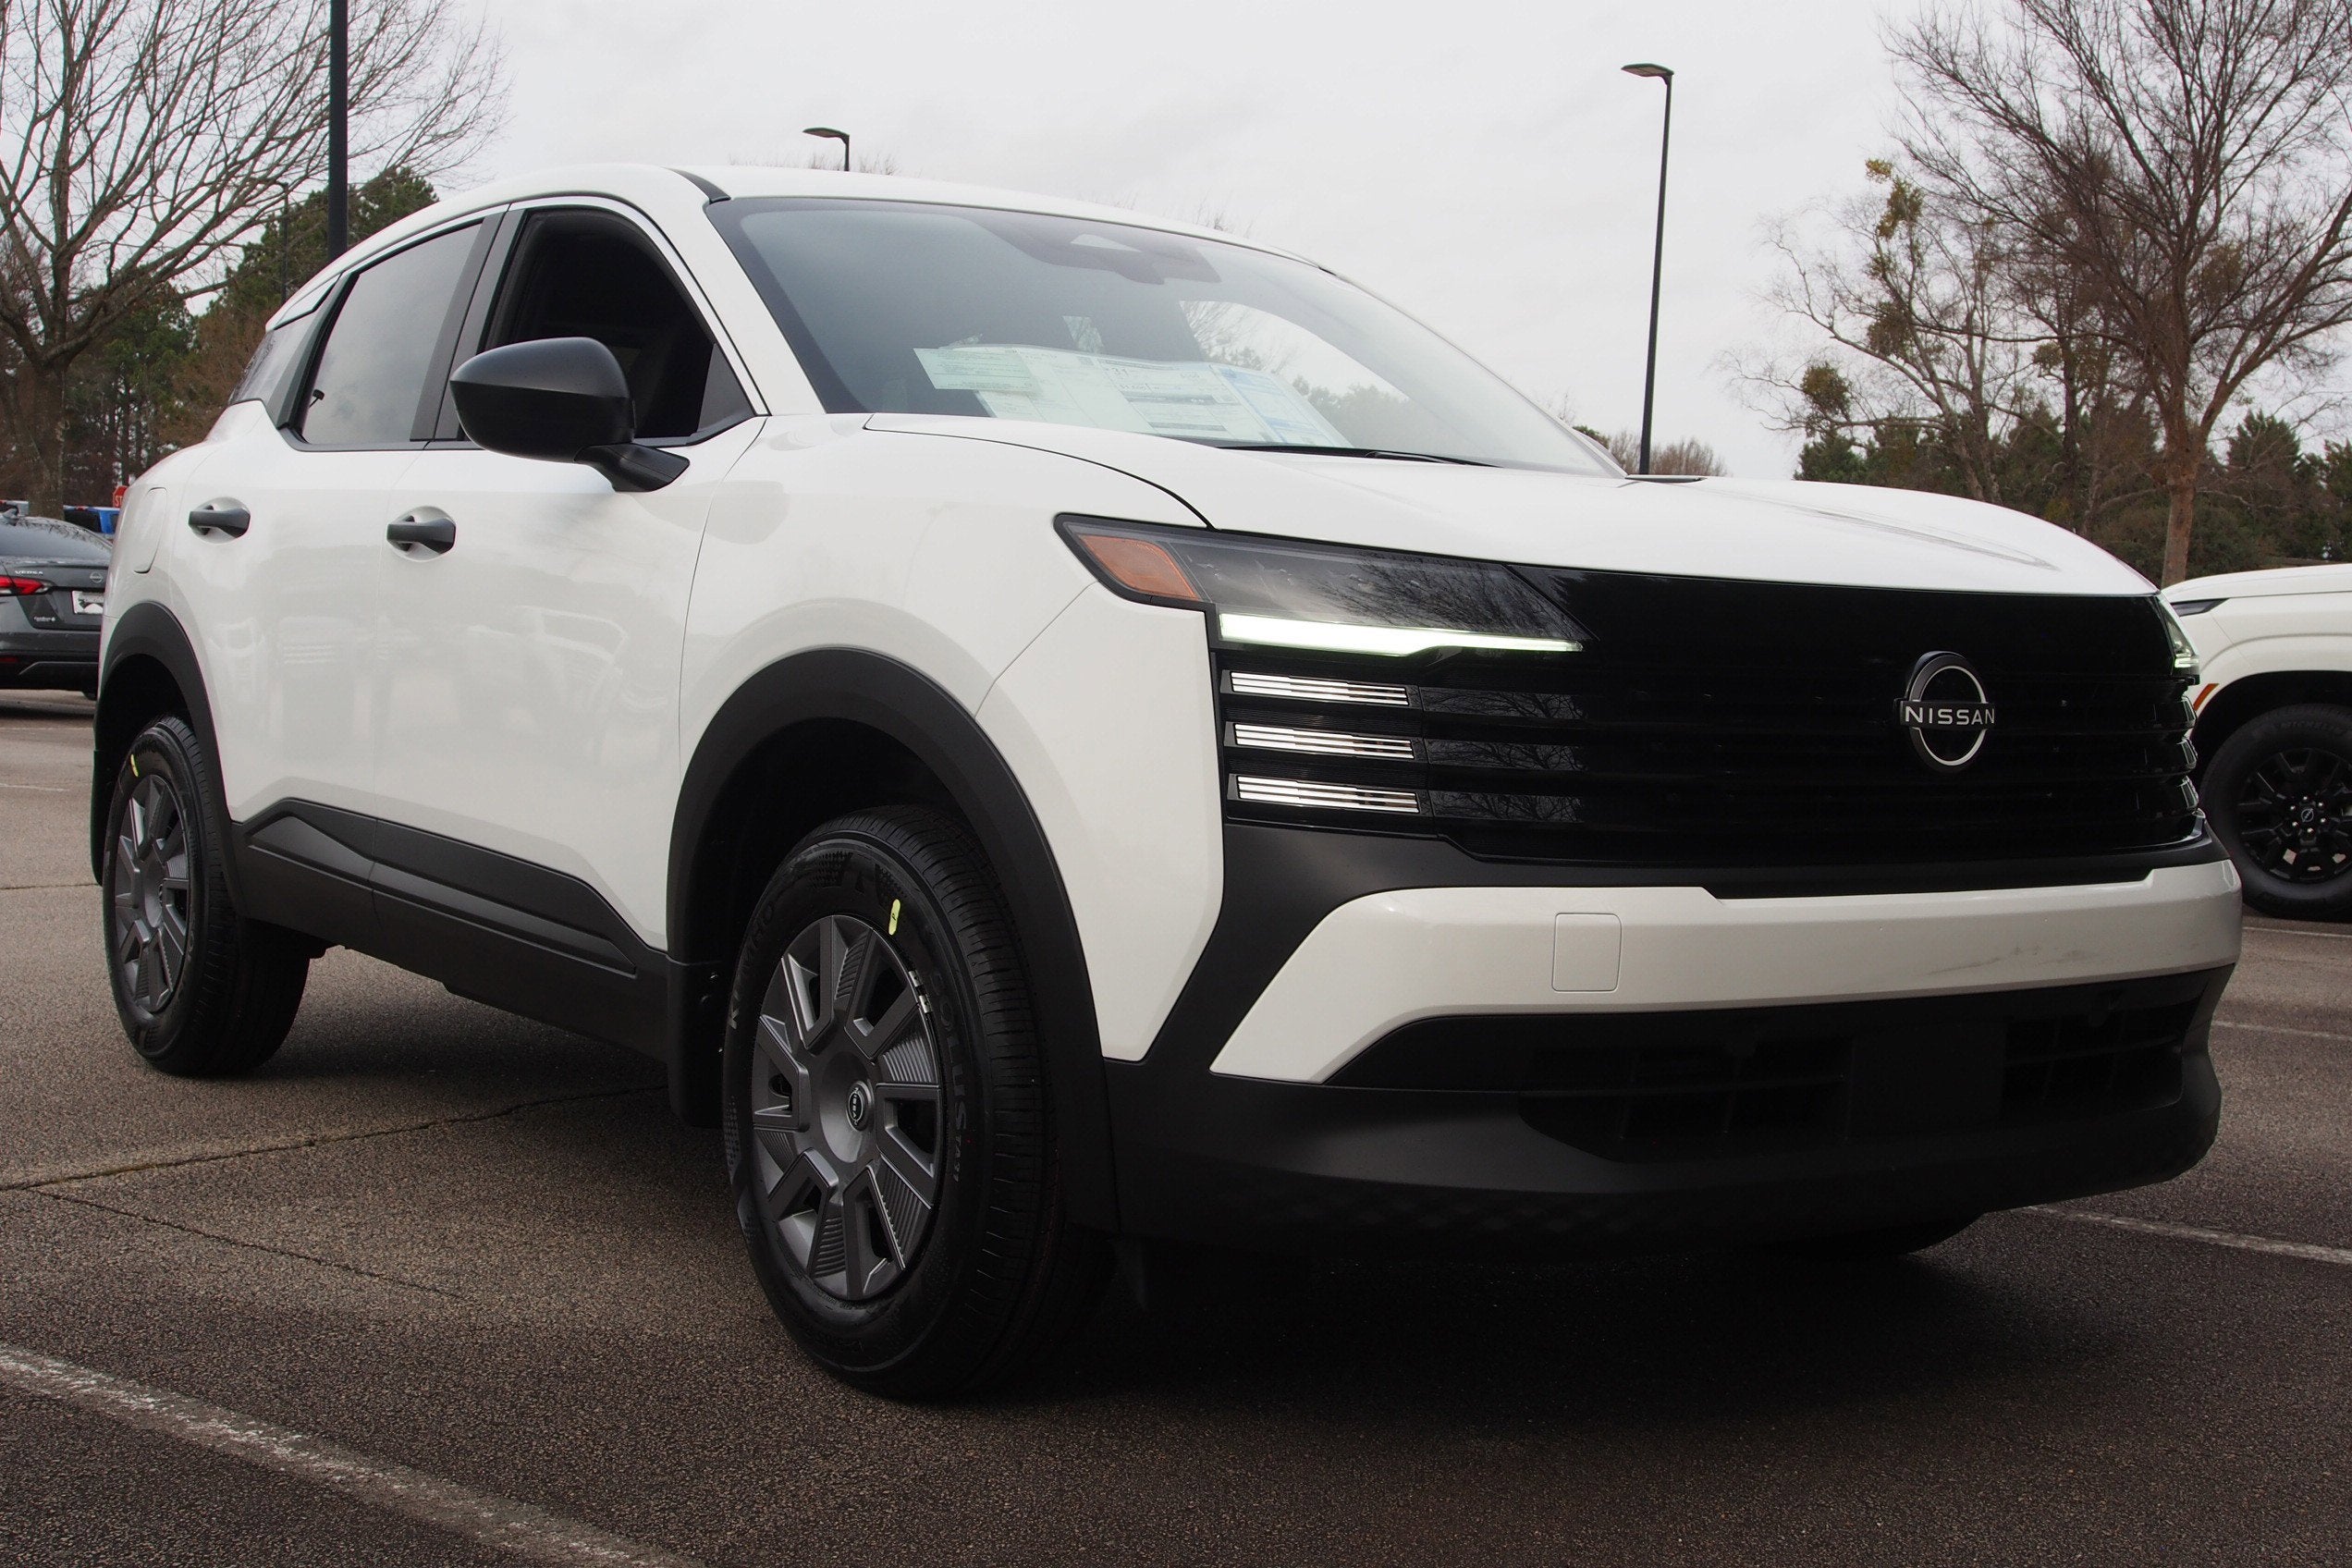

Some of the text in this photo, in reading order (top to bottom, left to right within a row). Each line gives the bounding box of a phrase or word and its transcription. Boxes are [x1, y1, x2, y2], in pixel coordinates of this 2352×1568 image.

[115, 495, 123, 507] ST
[1905, 705, 1995, 725] NISSAN
[930, 967, 967, 1130] SOLUS
